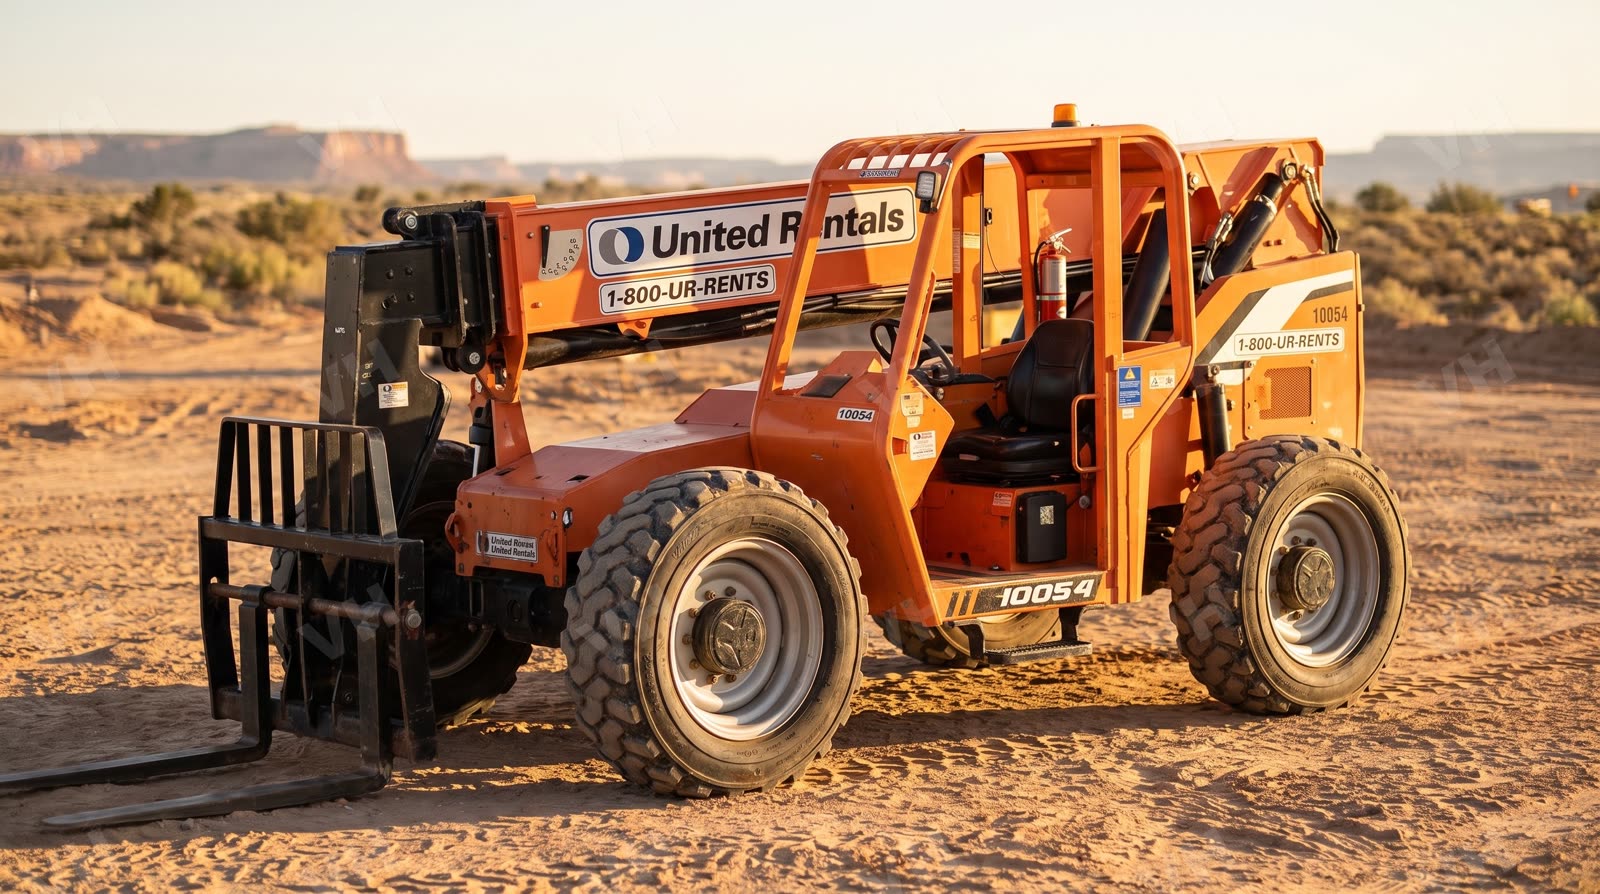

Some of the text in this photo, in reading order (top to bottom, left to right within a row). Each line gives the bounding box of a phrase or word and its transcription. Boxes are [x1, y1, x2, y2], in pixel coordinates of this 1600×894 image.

[652, 201, 904, 259] United Rntals
[607, 270, 769, 308] 1-800-UR-RENTS
[1313, 305, 1348, 324] 10054
[1238, 332, 1339, 351] 1-800-UR-RENTS
[838, 408, 873, 421] 10054
[491, 536, 512, 546] United
[491, 545, 536, 558] United Rentals
[1000, 579, 1095, 607] 10054
